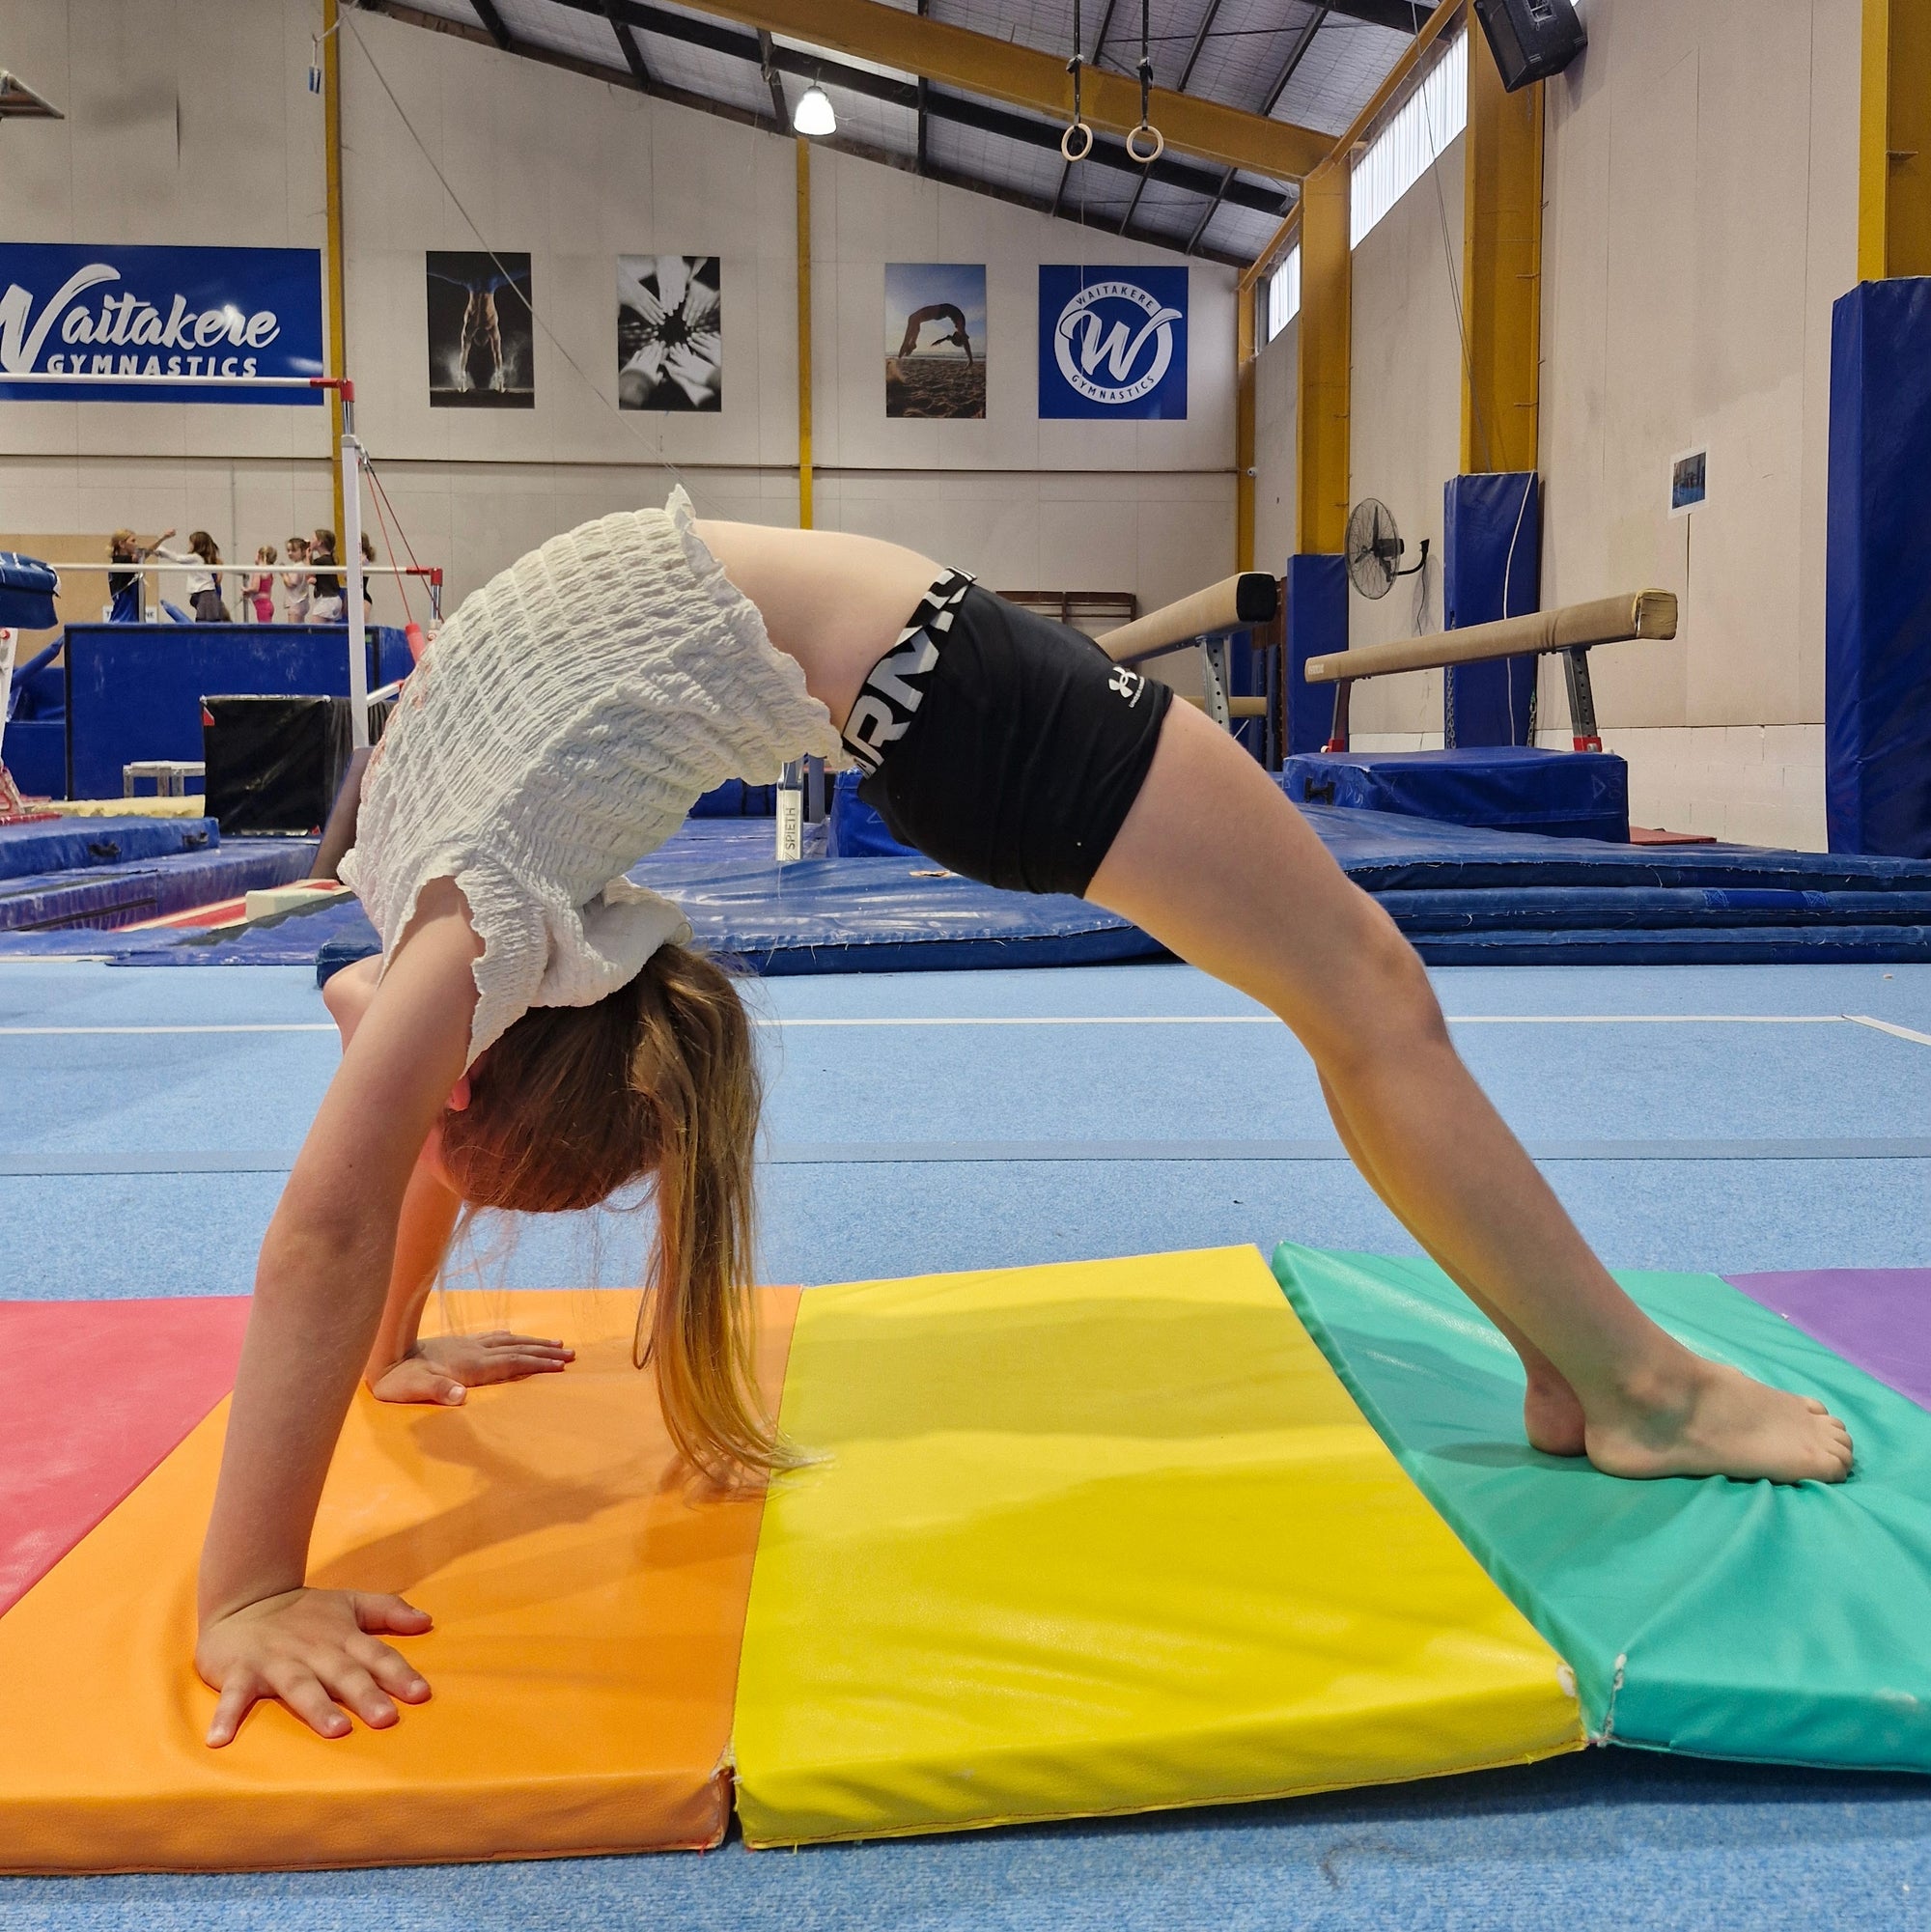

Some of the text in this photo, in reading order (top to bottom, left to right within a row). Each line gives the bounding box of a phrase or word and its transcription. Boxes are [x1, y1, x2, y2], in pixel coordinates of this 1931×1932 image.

[1077, 285, 1154, 307] WAITAKERE
[46, 353, 258, 378] GYMNASTICS
[1072, 375, 1155, 401] GYMNASTICS
[784, 807, 796, 851] SPIETH
